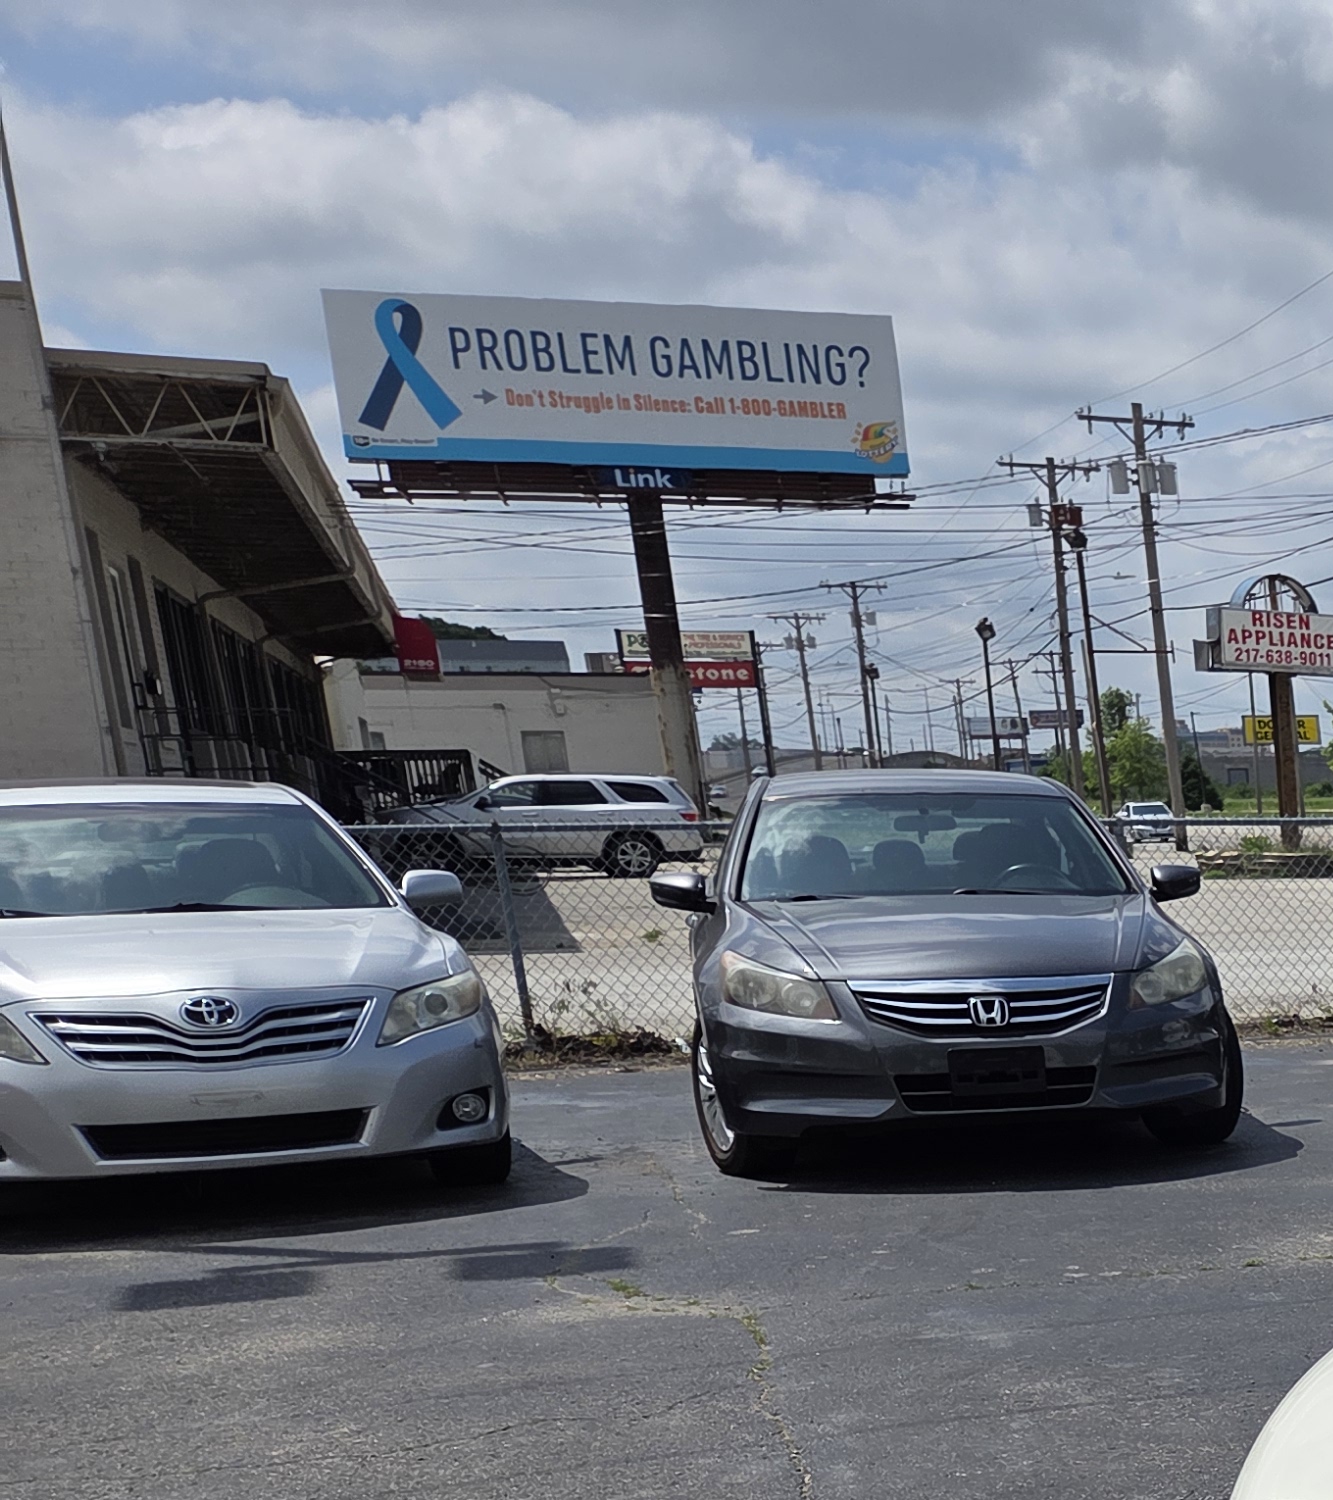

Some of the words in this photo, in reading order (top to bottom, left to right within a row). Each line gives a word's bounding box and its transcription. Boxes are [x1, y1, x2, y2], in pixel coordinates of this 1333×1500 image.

[448, 327, 637, 376] PROBLEM
[649, 335, 871, 388] GAMBLING?
[505, 388, 546, 408] Don't
[549, 390, 614, 414] Struggle
[633, 393, 692, 413] Silence:
[693, 396, 726, 414] Call
[728, 397, 847, 419] 1-800-GAMBLER
[614, 468, 675, 489] Link
[1251, 611, 1311, 631] RISEN
[1234, 647, 1332, 667] 217-638-9011
[1257, 720, 1306, 730] DOR
